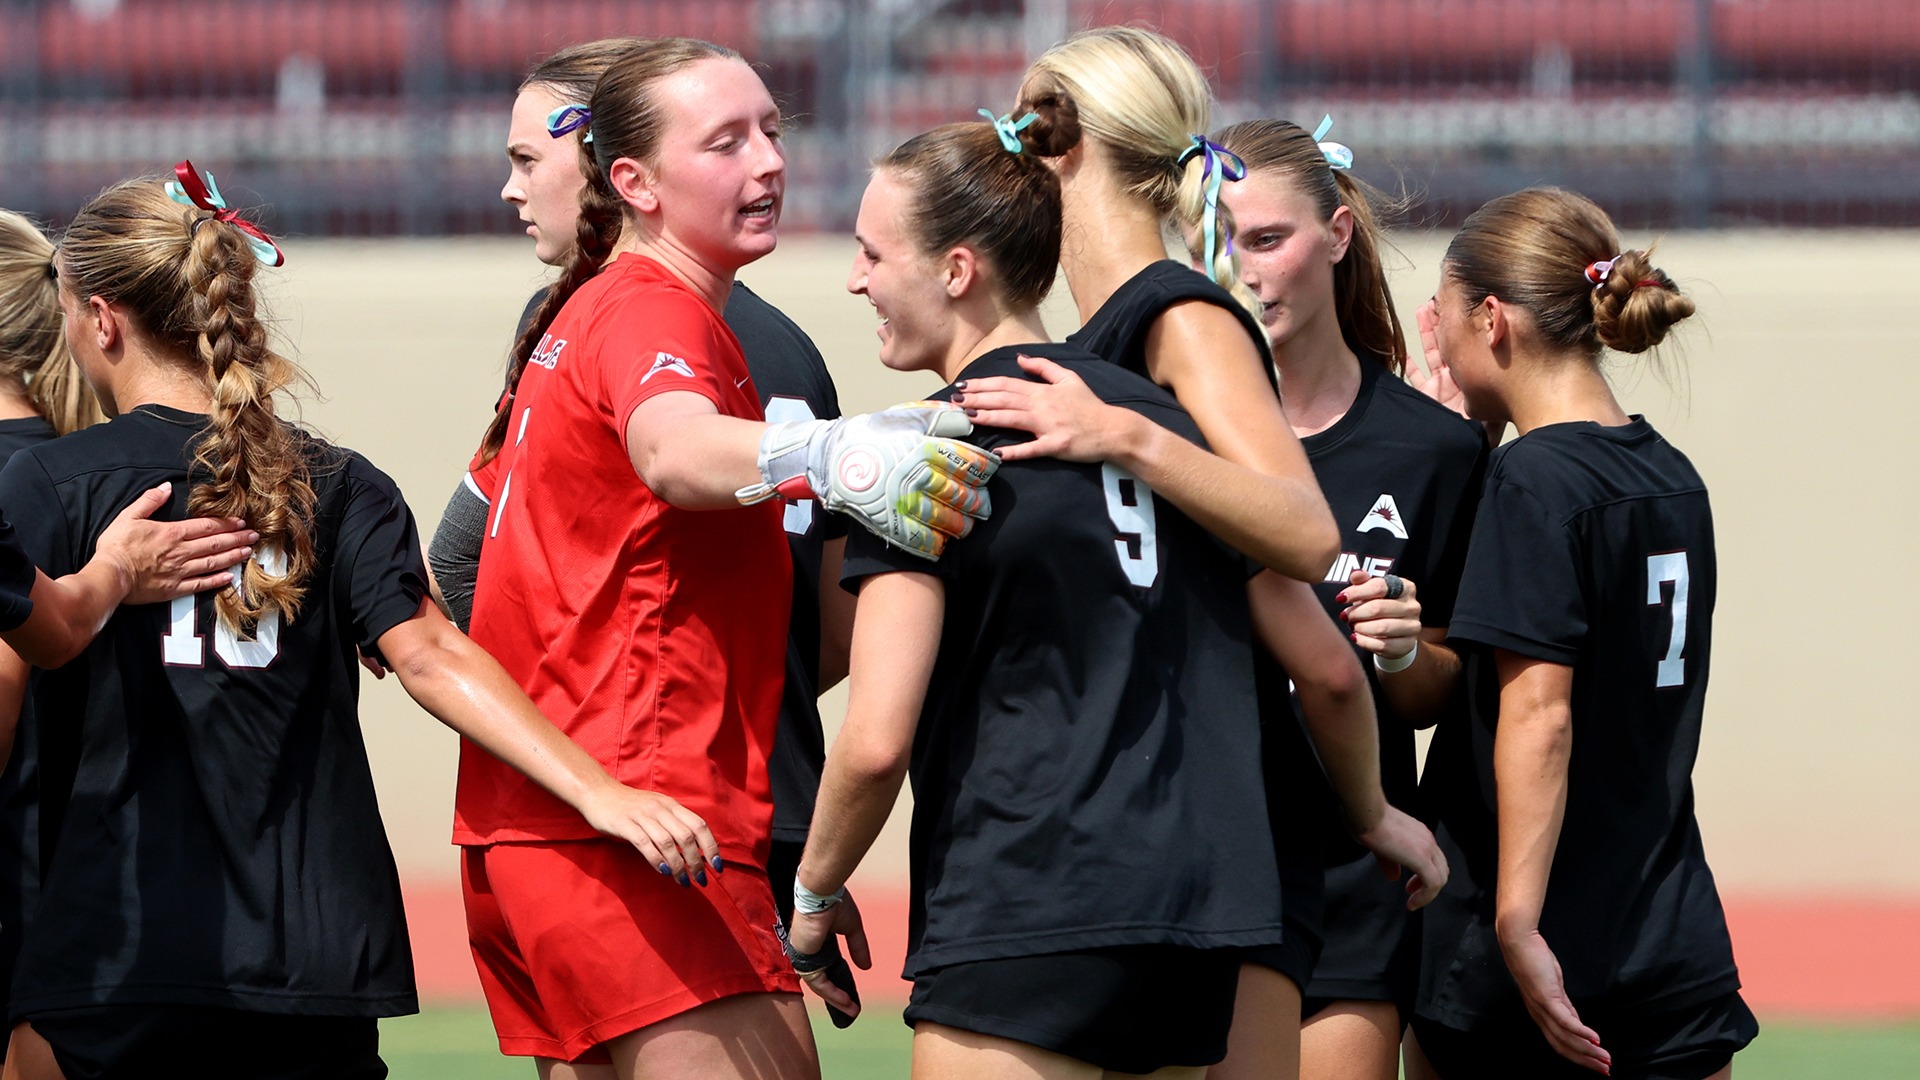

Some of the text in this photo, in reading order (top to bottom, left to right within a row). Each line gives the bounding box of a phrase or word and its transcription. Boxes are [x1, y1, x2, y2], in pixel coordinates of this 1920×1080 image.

[937, 447, 967, 467] WEST
[1101, 460, 1159, 588] 9
[1646, 550, 1690, 689] 7
